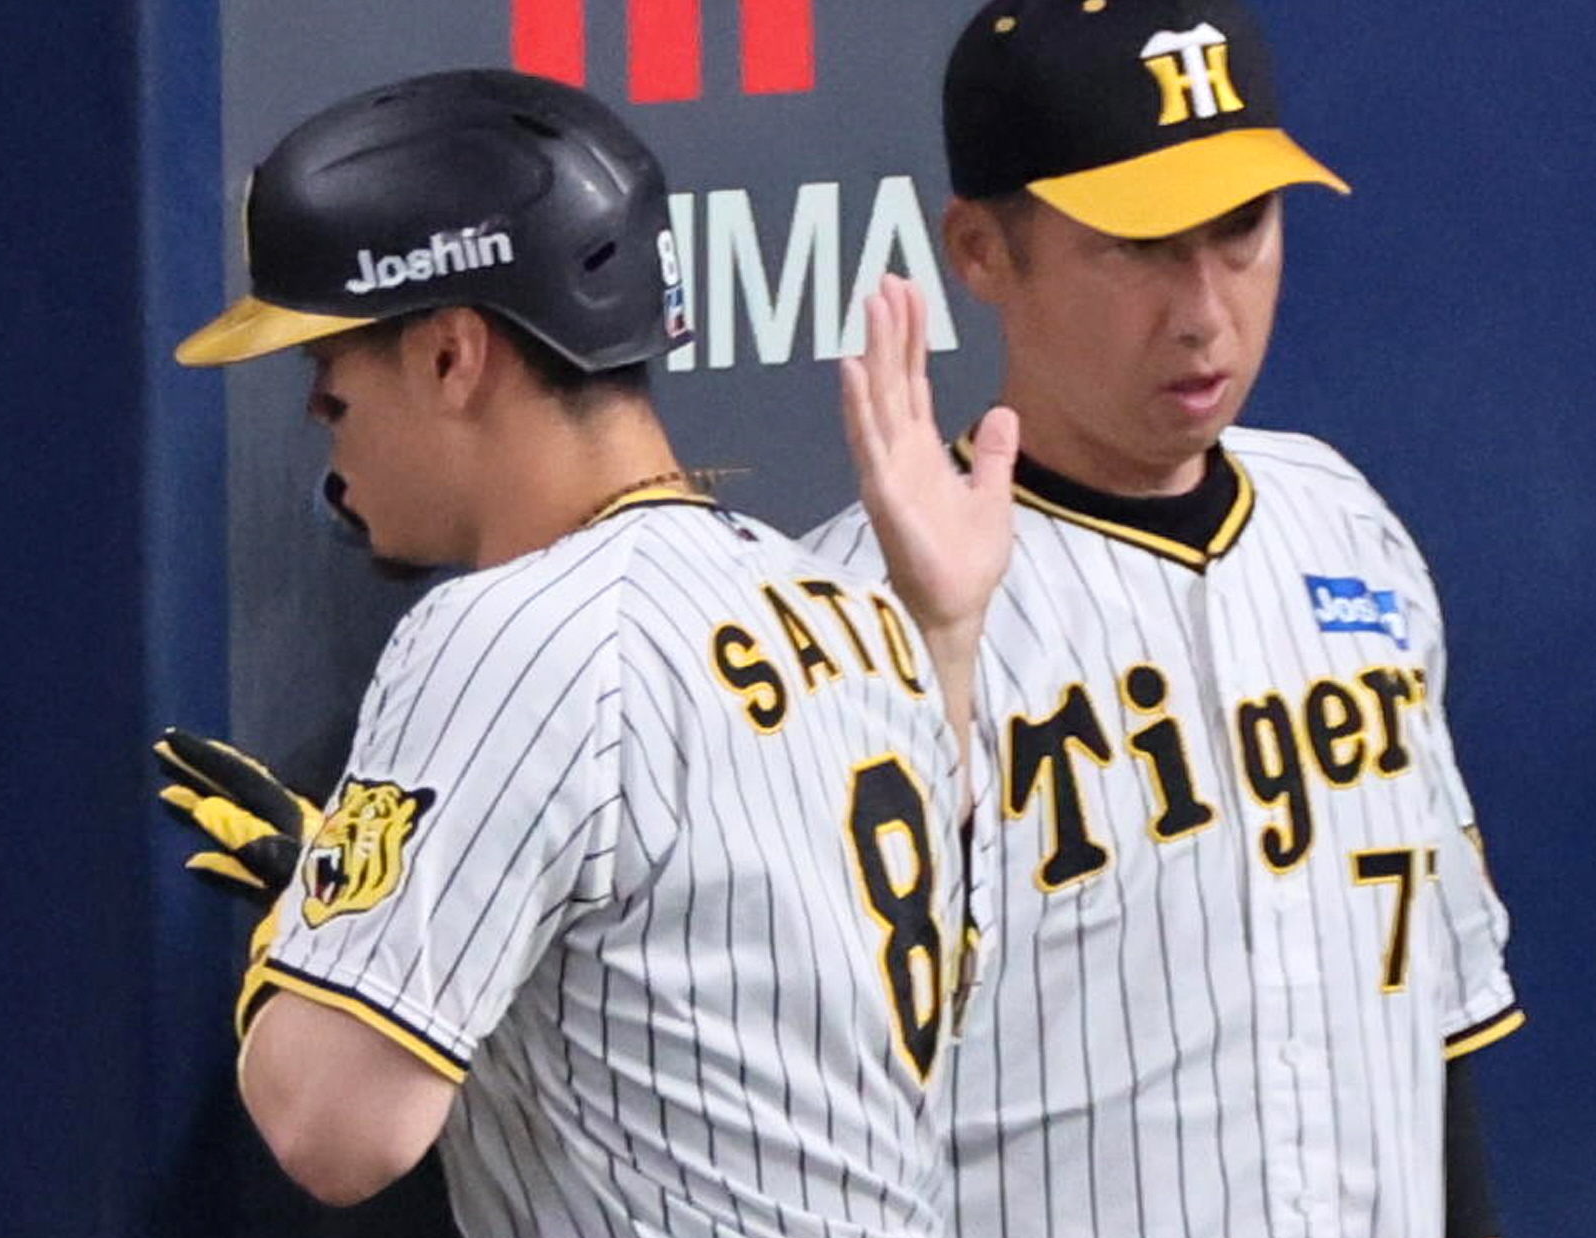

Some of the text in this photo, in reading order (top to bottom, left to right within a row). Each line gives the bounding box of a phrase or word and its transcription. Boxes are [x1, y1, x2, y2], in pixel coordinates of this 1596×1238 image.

[344, 226, 514, 294] Joshin
[1003, 663, 1427, 892] Tiger
[844, 749, 945, 1092] 8
